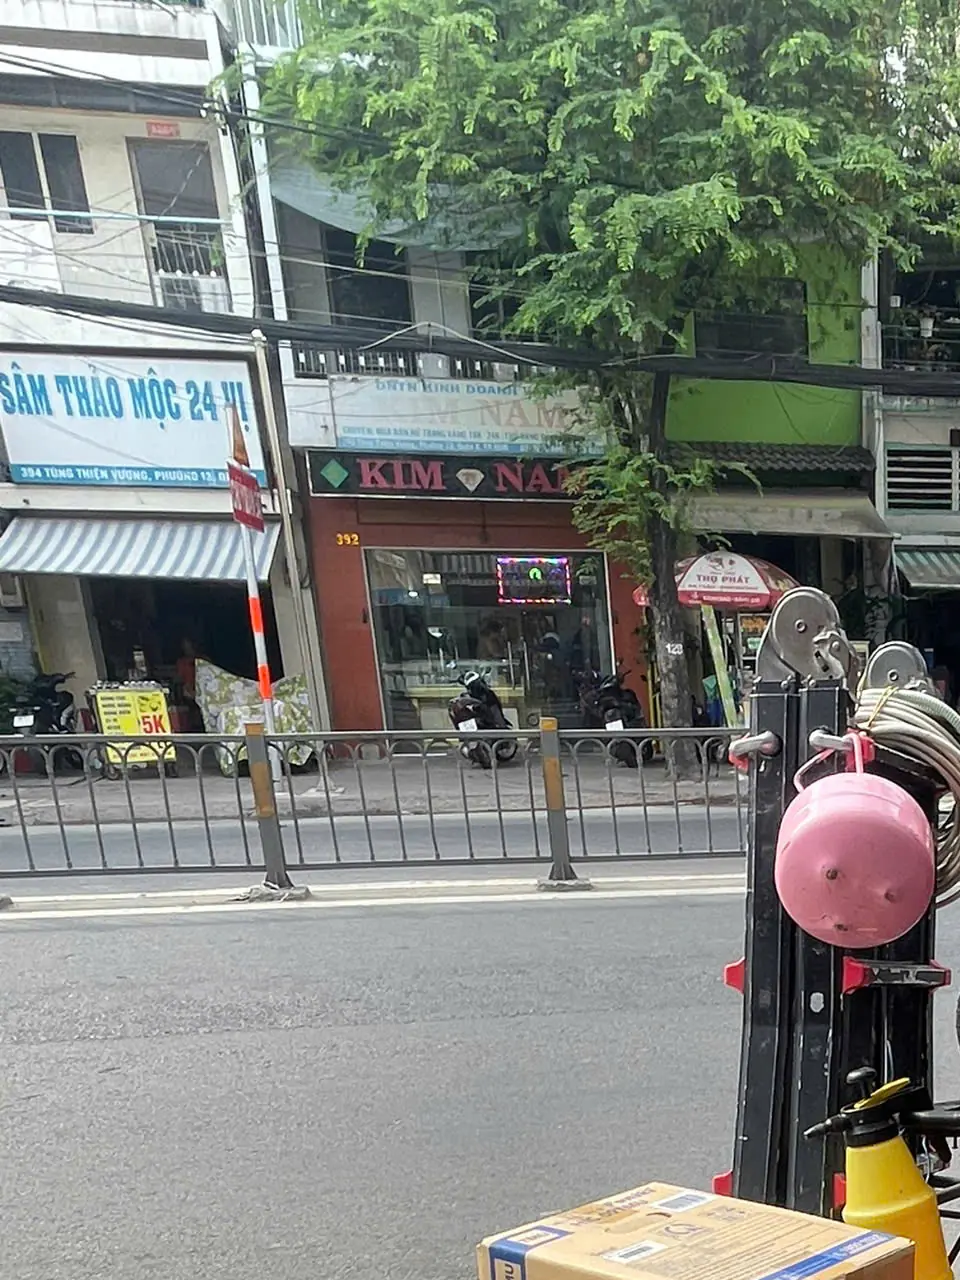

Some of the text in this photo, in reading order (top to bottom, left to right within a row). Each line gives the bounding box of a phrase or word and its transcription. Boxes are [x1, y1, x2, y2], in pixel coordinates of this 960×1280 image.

[0, 361, 53, 415] SÂM
[55, 364, 123, 418] THẢO
[127, 367, 181, 429] MỘC
[186, 381, 218, 421] 24
[357, 458, 447, 489] KIM
[336, 532, 360, 546] 392
[722, 574, 750, 584] PHÁT
[142, 714, 167, 734] 5K
